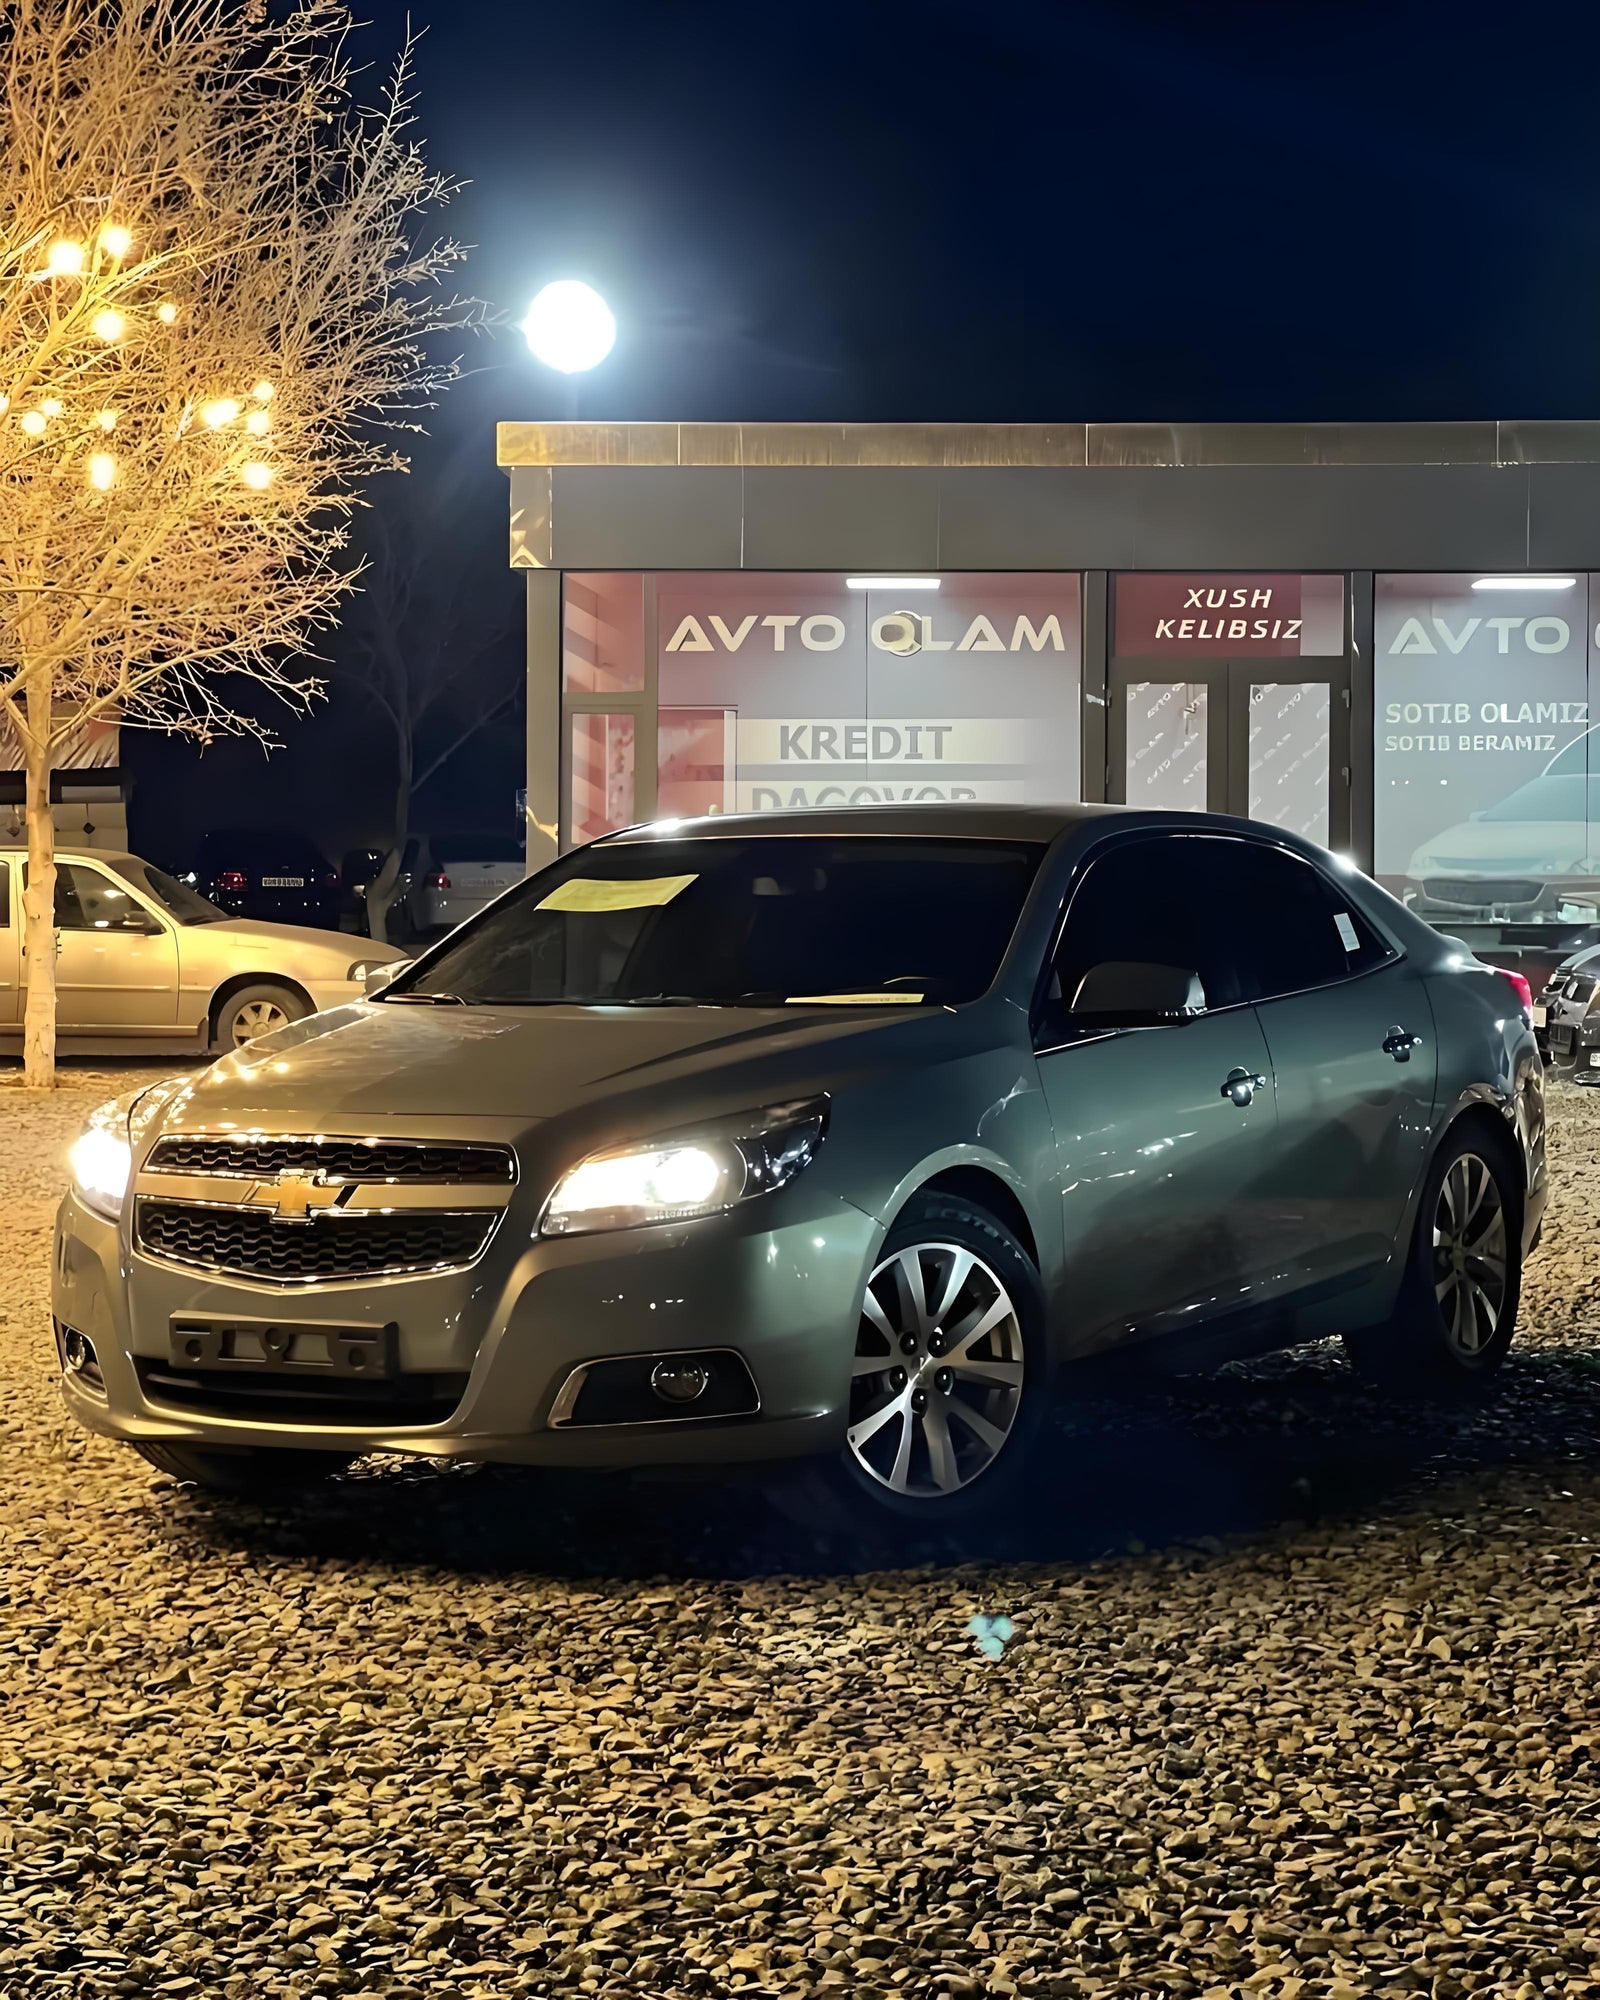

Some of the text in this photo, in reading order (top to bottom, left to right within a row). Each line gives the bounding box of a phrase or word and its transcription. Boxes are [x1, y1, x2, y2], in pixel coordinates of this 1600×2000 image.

[1183, 588, 1273, 609] XUSH
[665, 611, 1066, 655] AVTO OLAM
[1155, 619, 1303, 639] KELIBSIZ
[1388, 616, 1570, 655] AVTO
[1385, 702, 1589, 724] SOTIB OLAMIZ
[780, 725, 953, 760] KREDIT
[1385, 735, 1556, 751] SOTIB BERAMIZ
